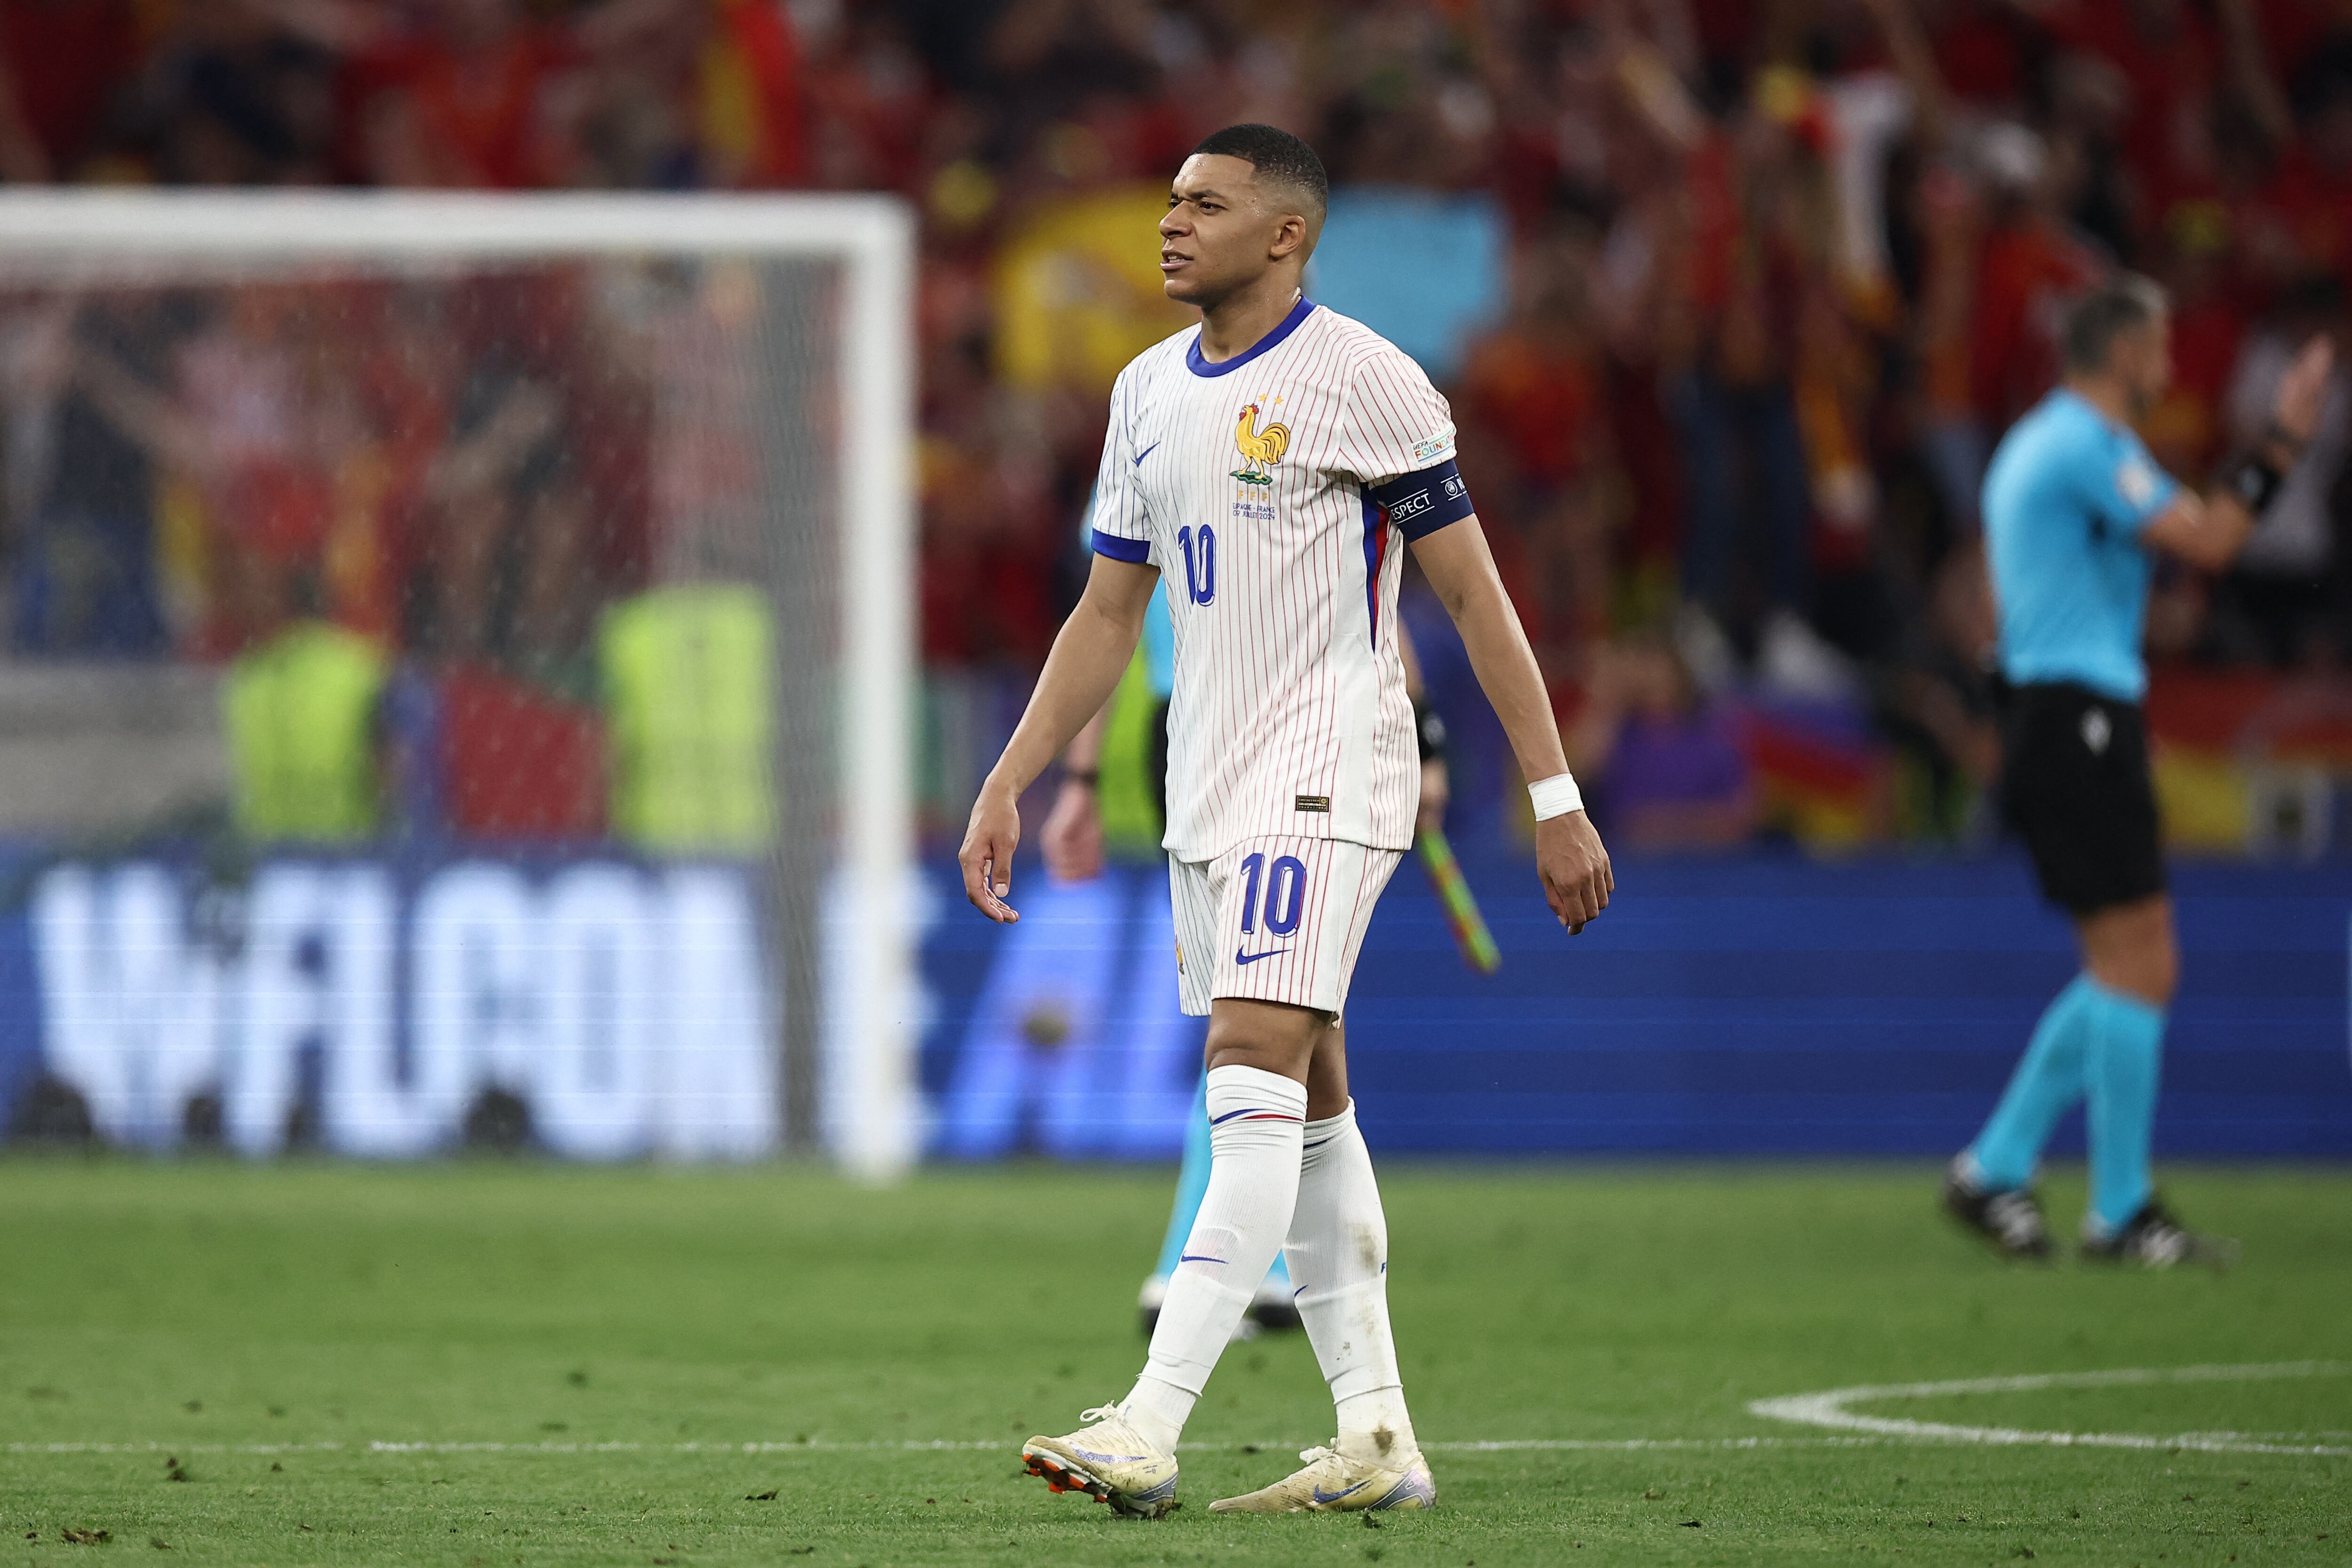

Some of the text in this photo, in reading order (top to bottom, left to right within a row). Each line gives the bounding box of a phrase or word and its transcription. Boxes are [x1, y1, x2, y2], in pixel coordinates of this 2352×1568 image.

[1413, 440, 1429, 450] UEFA
[1391, 493, 1430, 520] ESPECT
[1178, 524, 1216, 607] 10
[1240, 852, 1308, 938] 10
